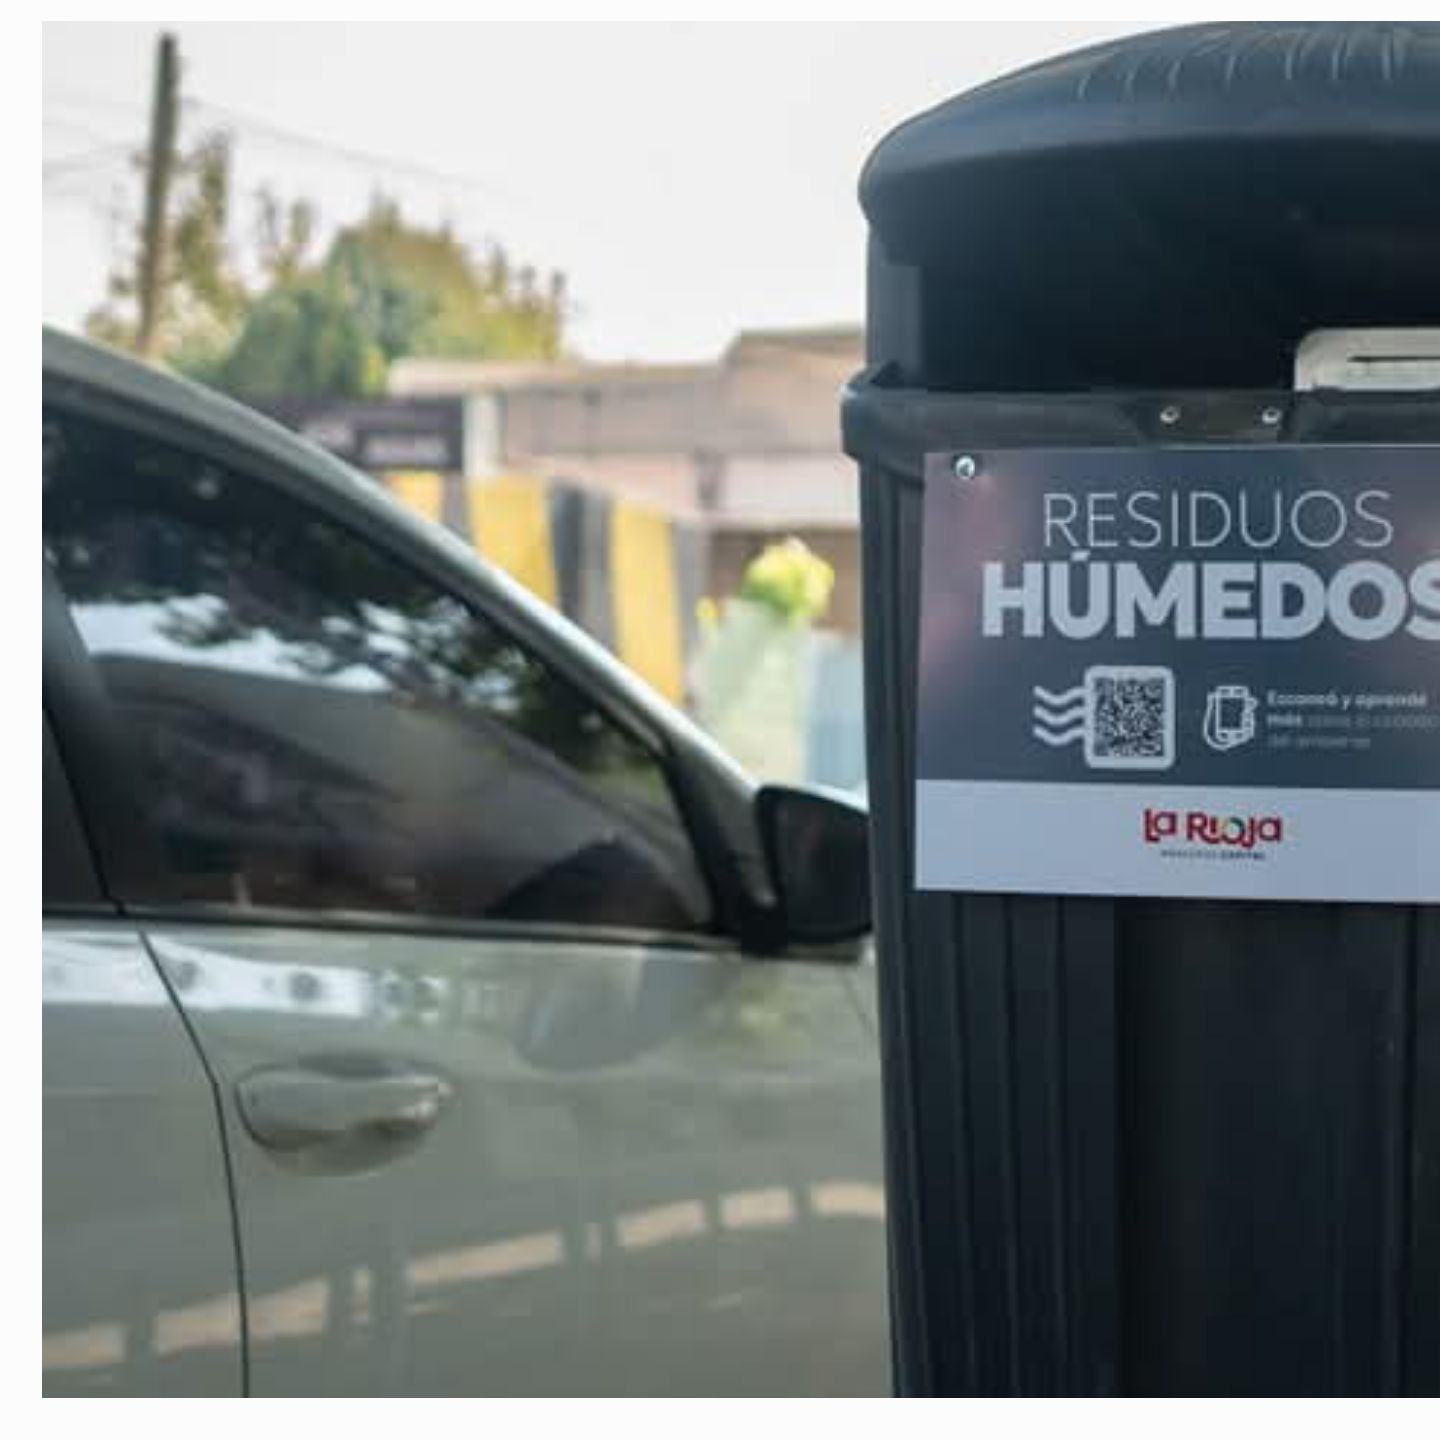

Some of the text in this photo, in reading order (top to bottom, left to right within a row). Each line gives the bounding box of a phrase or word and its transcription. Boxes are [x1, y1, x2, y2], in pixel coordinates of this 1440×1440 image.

[1043, 489, 1396, 549] RESIDUOS
[1342, 693, 1350, 712] y
[1144, 808, 1283, 851] La Rioja
